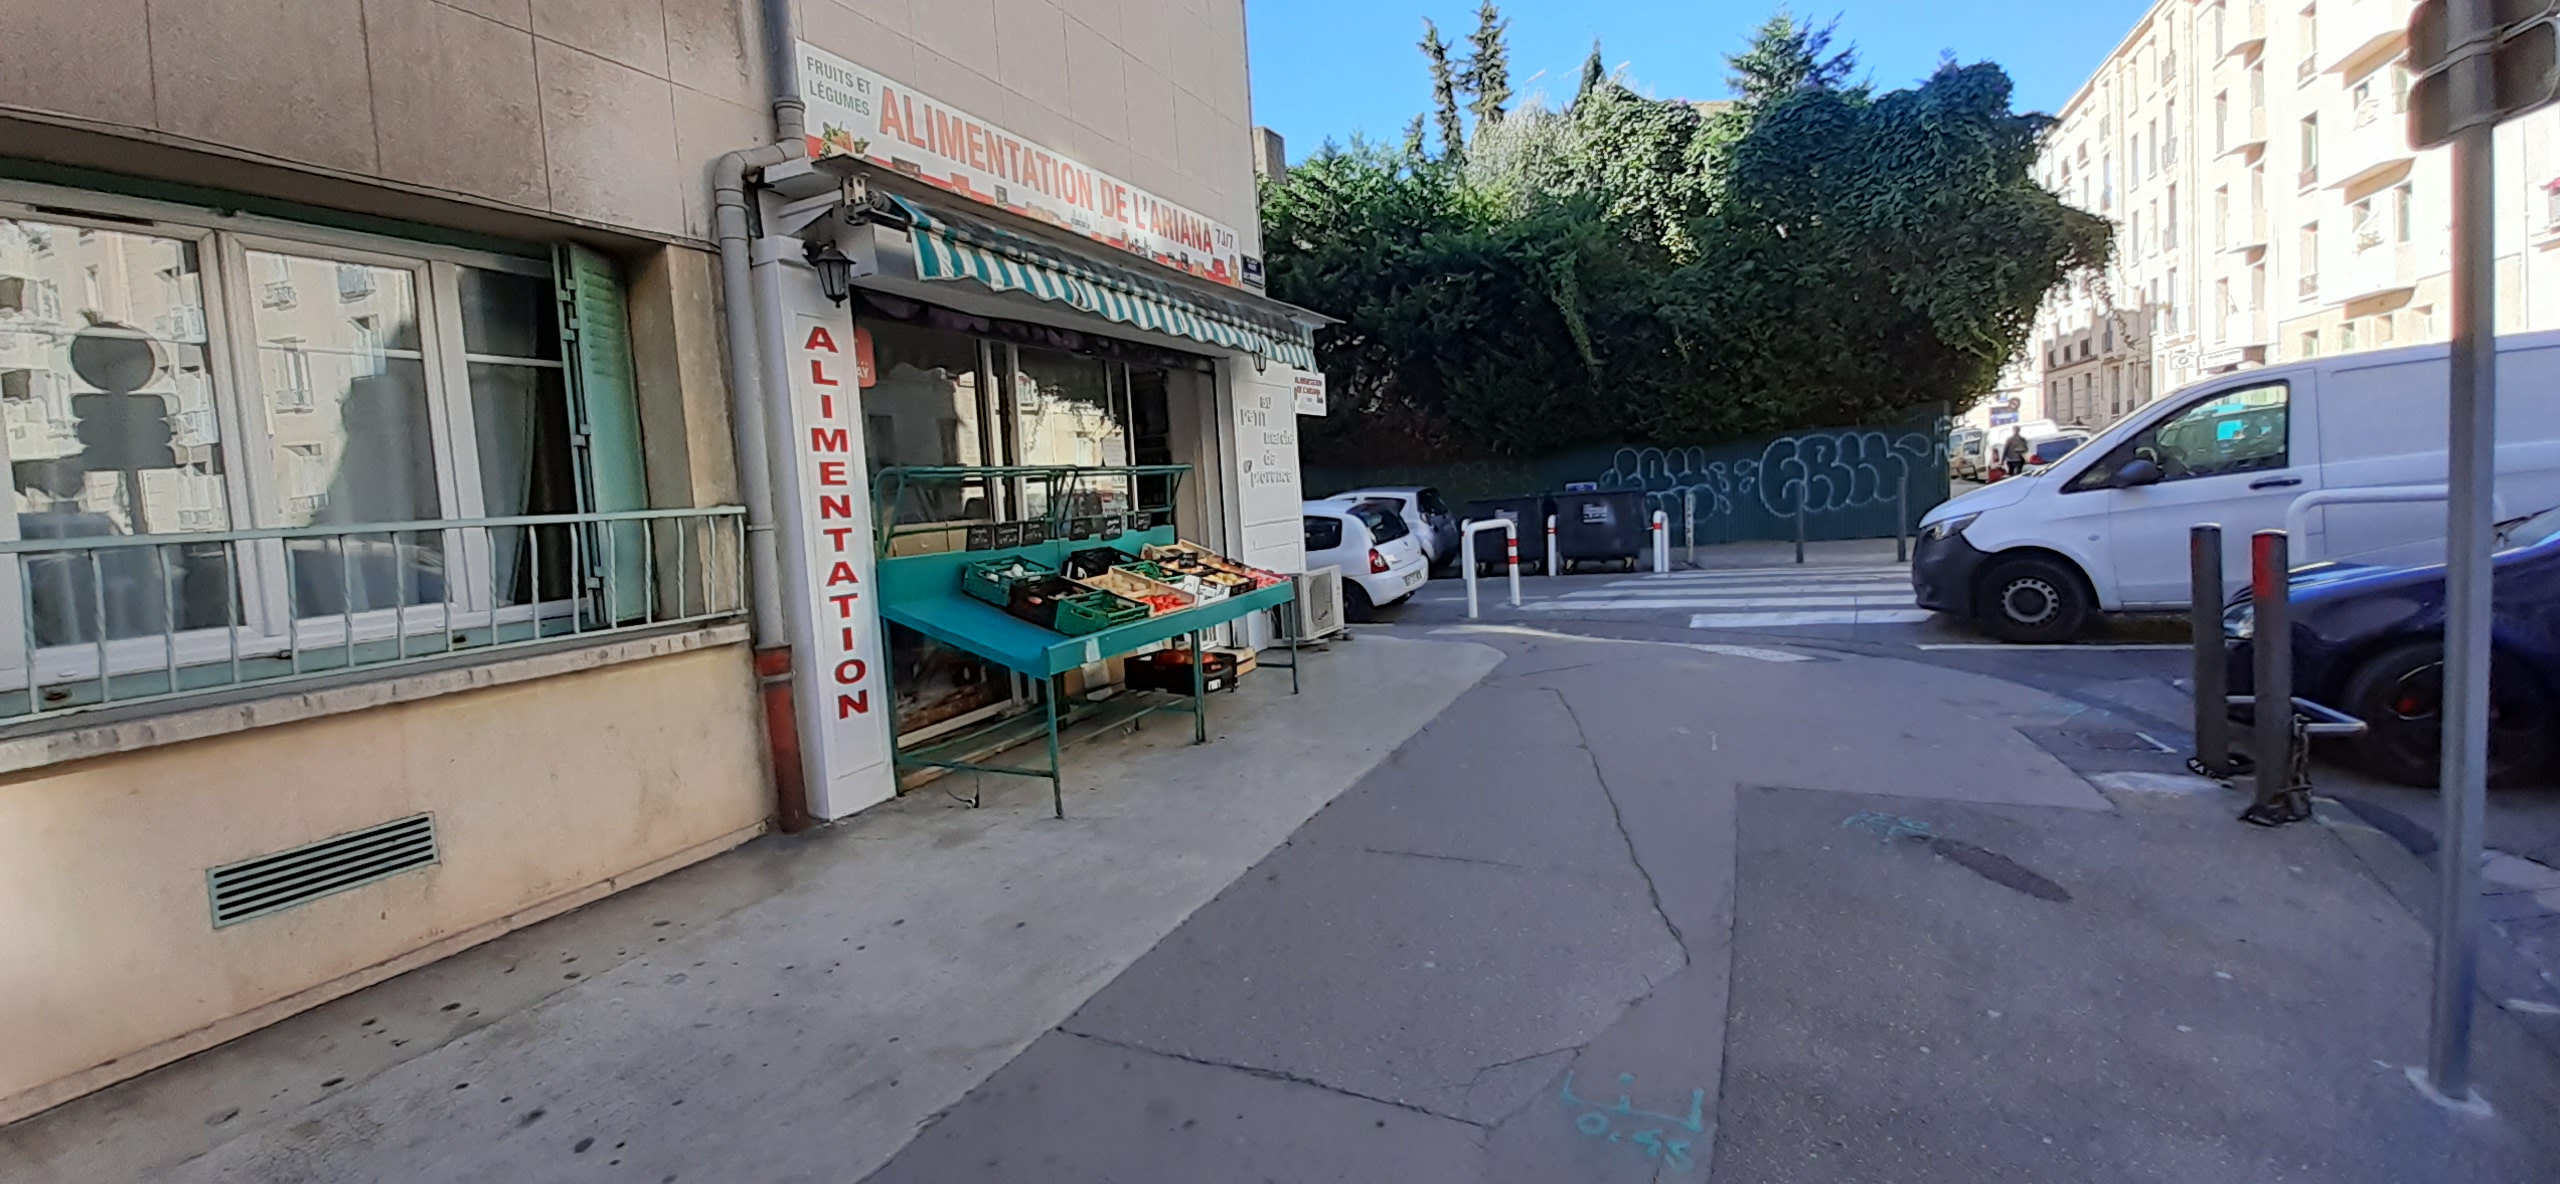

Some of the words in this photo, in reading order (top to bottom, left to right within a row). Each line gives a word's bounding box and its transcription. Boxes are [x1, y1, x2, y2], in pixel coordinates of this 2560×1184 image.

[806, 55, 854, 88] FRUITS
[856, 76, 871, 95] ET
[808, 79, 870, 116] LÉGUMES
[879, 85, 1094, 212] ALIMENTATION
[1100, 177, 1129, 224] DE
[1132, 191, 1214, 255] L'ARIANA
[804, 325, 870, 720] ALIMENTATION
